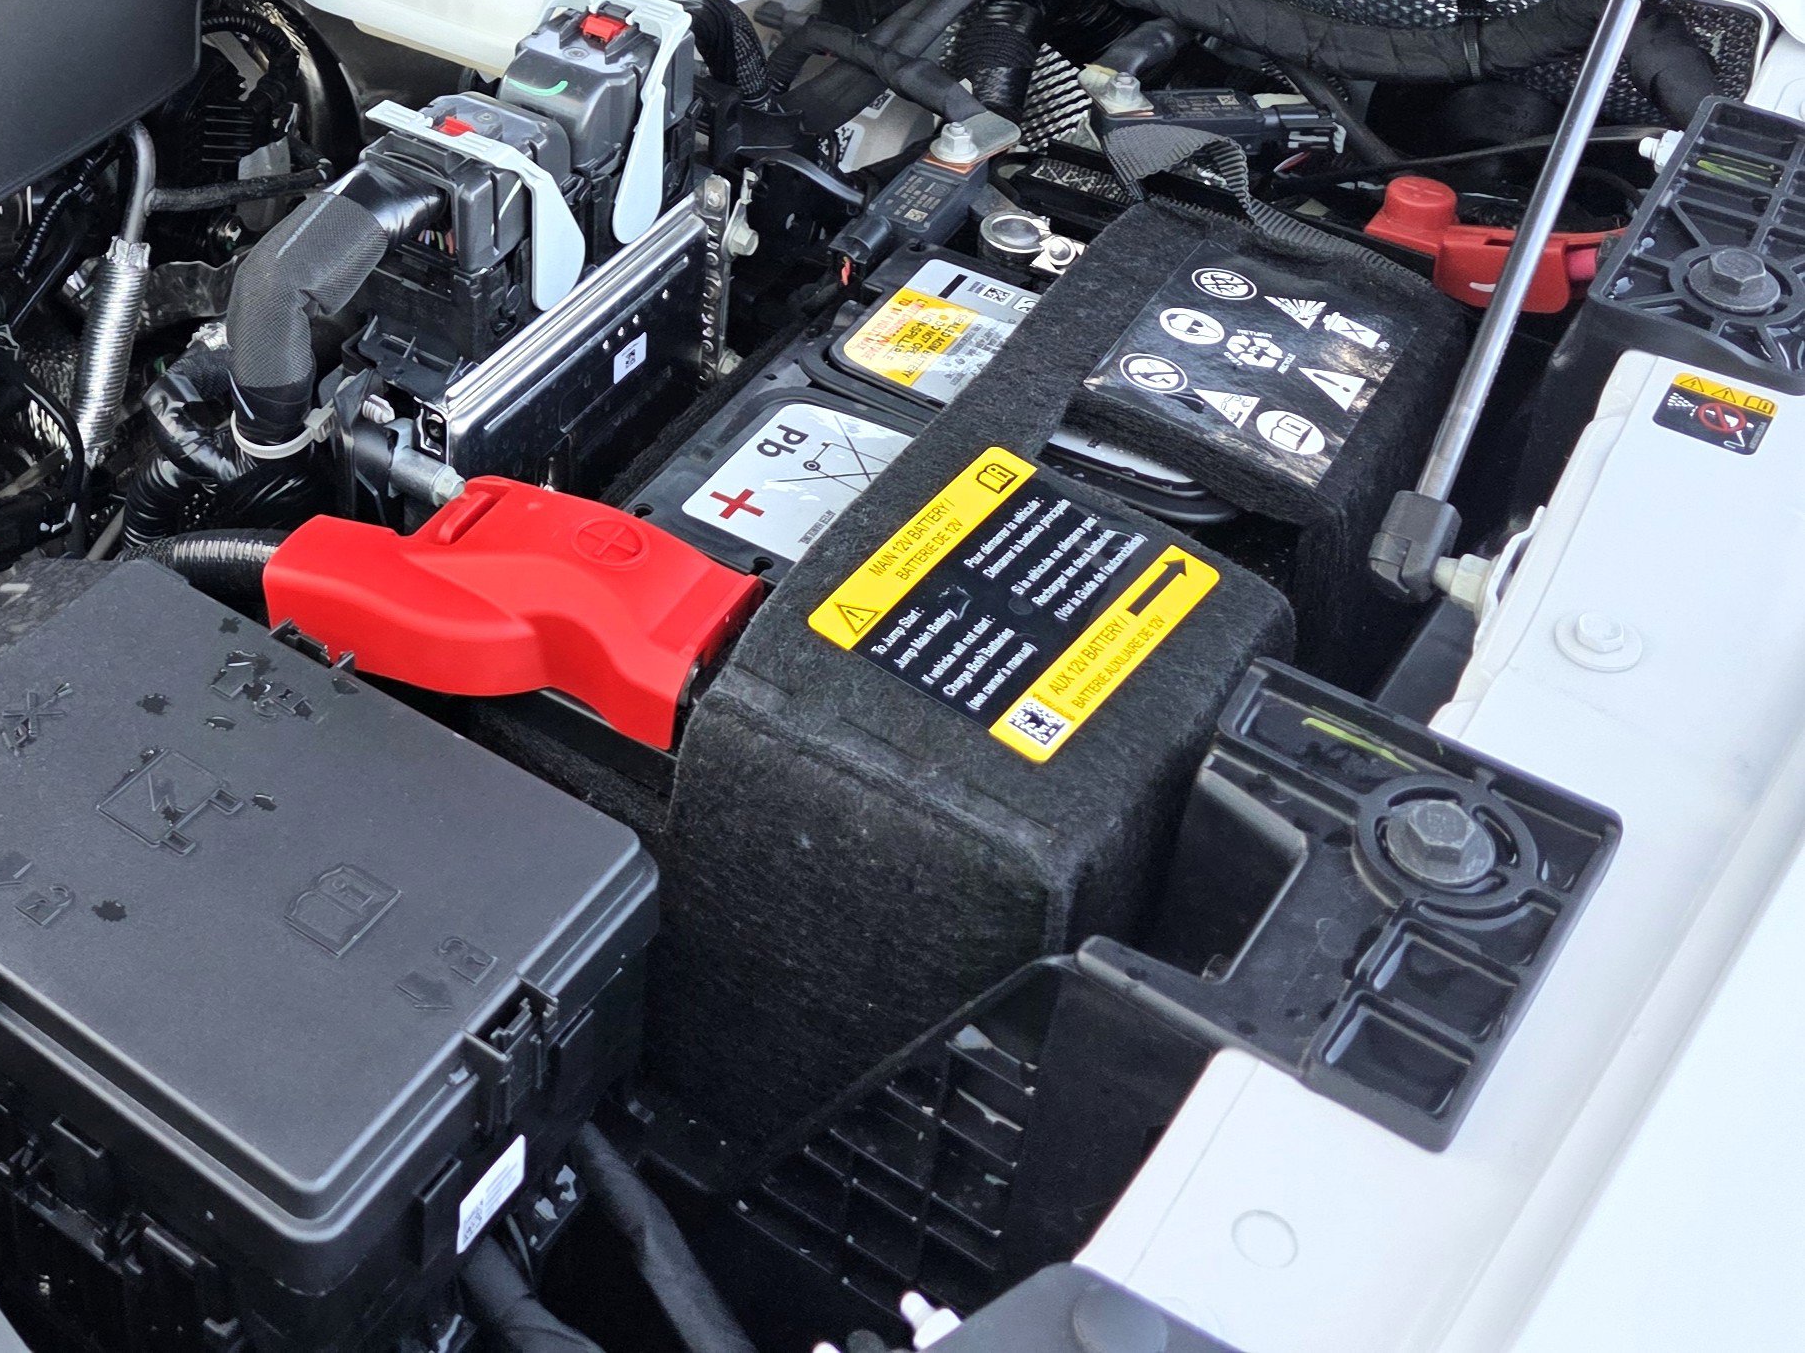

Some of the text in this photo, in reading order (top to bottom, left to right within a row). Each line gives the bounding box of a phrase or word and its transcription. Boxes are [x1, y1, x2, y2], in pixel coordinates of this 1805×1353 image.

[756, 424, 810, 458] Pb
[867, 550, 899, 576] MAIN
[890, 535, 915, 555] 12V
[905, 501, 951, 540] BATTERY
[894, 517, 965, 580] BATTERIE DE 12V
[962, 549, 987, 568] Pour
[1009, 583, 1027, 596] Si
[1080, 515, 1100, 531] pas
[1030, 526, 1117, 608] Recharger les deux batteries
[896, 608, 923, 629] Start
[1052, 600, 1079, 622] (Voir
[1072, 577, 1100, 600] Guide
[870, 642, 889, 656] To
[879, 624, 909, 648] Jump
[890, 606, 961, 670] Jump Main Battery
[925, 651, 958, 679] vehicle
[948, 640, 969, 657] will
[959, 630, 979, 646] not
[970, 616, 993, 635] start
[940, 625, 1016, 699] Charge Both Batteries
[1046, 670, 1075, 695] AUX
[1064, 654, 1091, 676] 12V
[1080, 618, 1126, 661] BATTERY
[1070, 614, 1167, 709] BATTERIE AUXILIAIRE DE 12V
[963, 640, 1039, 712] (see owner's manual)
